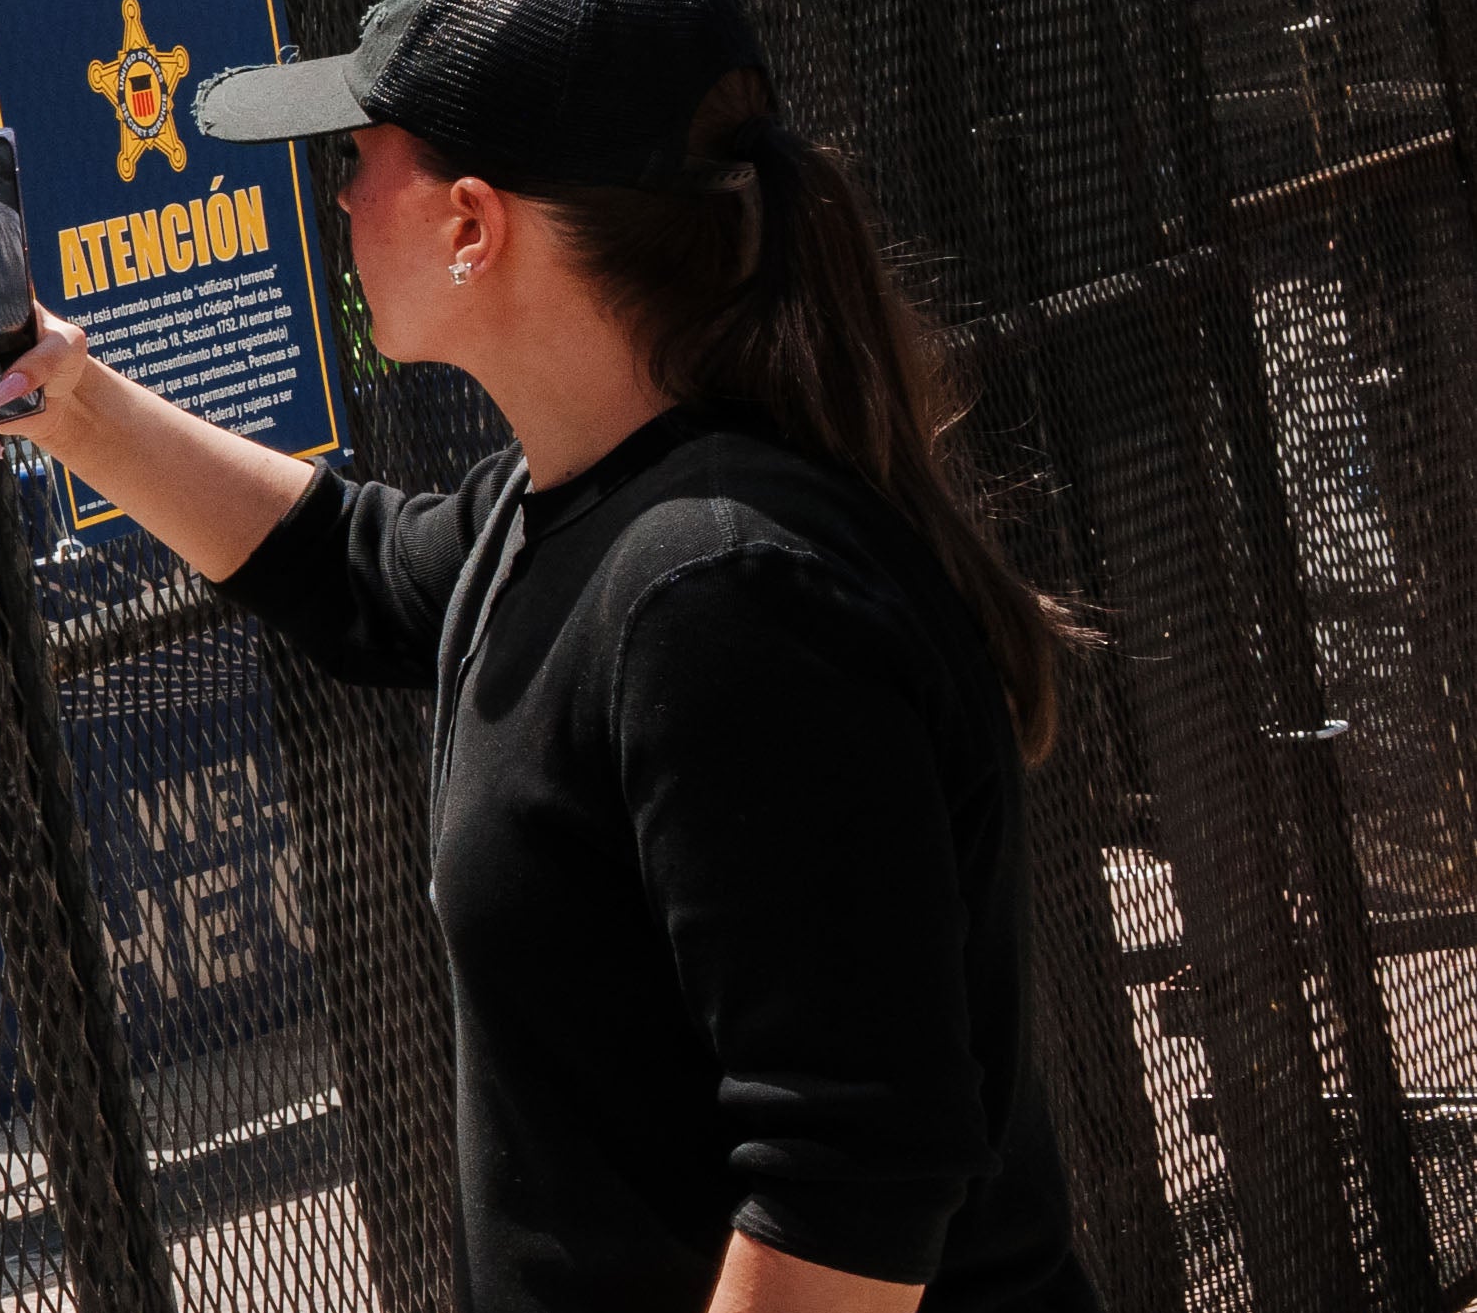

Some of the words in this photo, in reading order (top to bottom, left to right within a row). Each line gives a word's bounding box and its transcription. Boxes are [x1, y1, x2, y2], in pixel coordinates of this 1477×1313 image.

[119, 53, 137, 90] UNITED
[137, 51, 164, 83] STATES
[121, 103, 147, 137] SECRET
[148, 93, 167, 137] SERVICE
[58, 174, 269, 300] ATENCIÓN
[105, 327, 128, 342] como
[174, 309, 193, 324] bajo
[194, 306, 202, 319] el
[233, 291, 257, 308] Penal
[257, 289, 268, 302] de
[269, 287, 282, 299] los
[112, 298, 149, 318] entrando
[150, 296, 162, 308] un
[182, 288, 193, 300] de
[194, 278, 233, 296] "edificios
[233, 277, 239, 290] y
[240, 264, 278, 286] terrenos"
[102, 347, 135, 365] Unidos,
[169, 332, 182, 346] 18,
[216, 317, 238, 334] 1752.
[239, 314, 248, 328] Al
[249, 310, 272, 326] entrar
[139, 363, 147, 377] el
[148, 348, 210, 374] consentimiento
[211, 343, 222, 357] de
[223, 341, 236, 354] ser
[237, 325, 288, 351] registrado(a)
[166, 378, 182, 392] que
[183, 373, 198, 386] sus
[248, 349, 286, 368] Personas
[287, 344, 300, 358] sin
[192, 395, 198, 406] o
[199, 381, 246, 406] permanecer
[247, 378, 258, 390] en
[276, 367, 296, 382] zona
[205, 403, 236, 422] Federal
[236, 404, 242, 417] y
[243, 396, 272, 413] sujetas
[272, 394, 279, 404] a
[279, 390, 292, 402] ser
